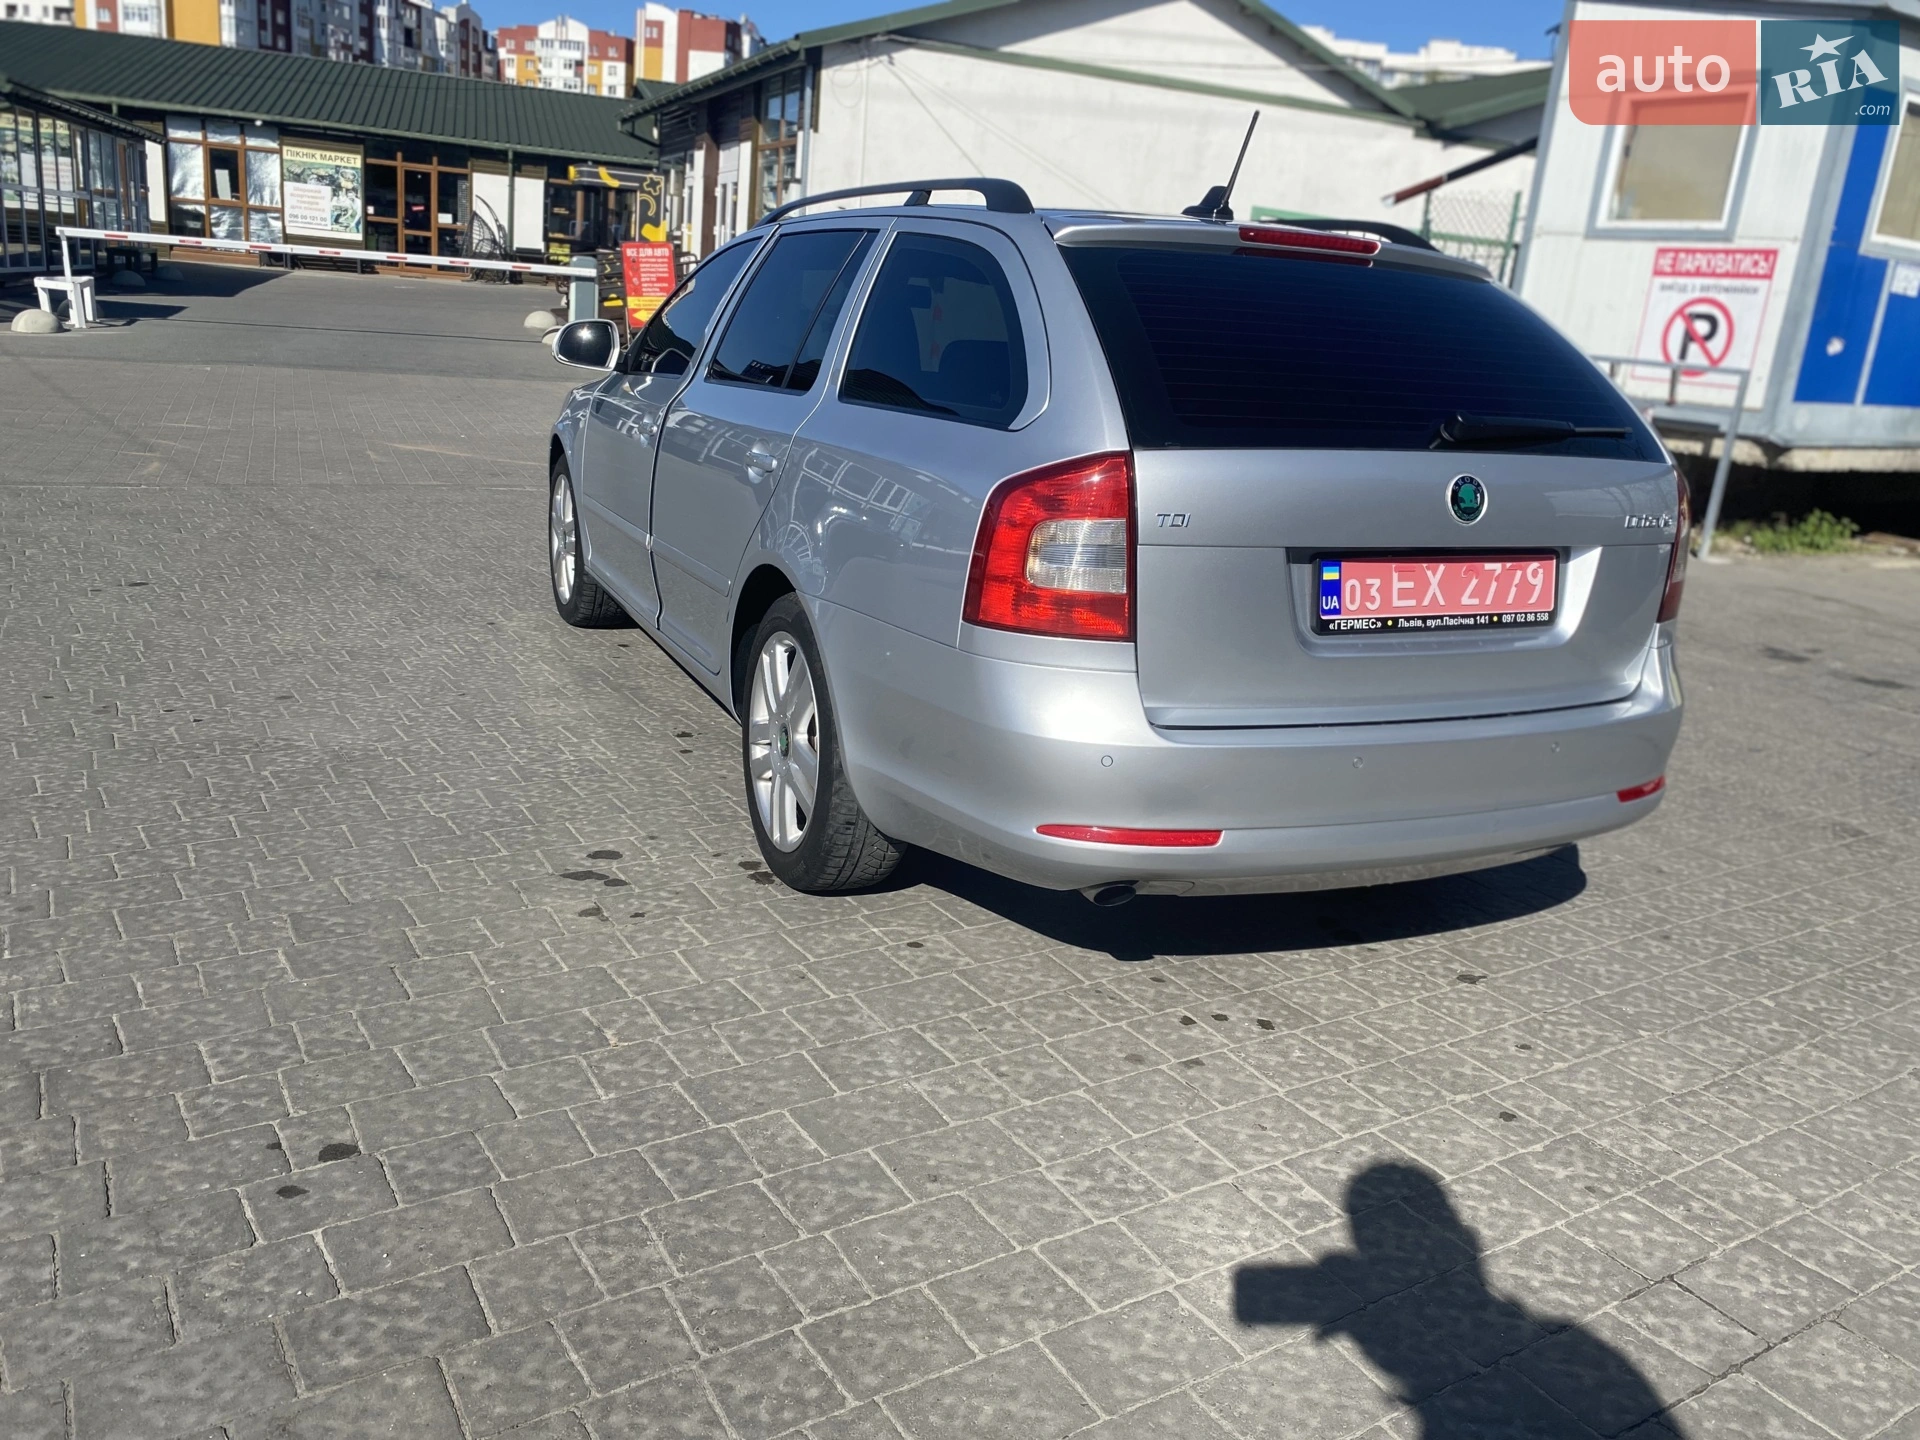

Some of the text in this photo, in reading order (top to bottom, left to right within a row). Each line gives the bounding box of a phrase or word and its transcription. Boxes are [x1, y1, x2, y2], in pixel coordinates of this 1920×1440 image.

[286, 149, 358, 165] ПІКНІК МАРКЕТ
[1657, 251, 1677, 274] НЕ
[1155, 513, 1191, 528] TDI
[1345, 562, 1544, 611] 03 EX 2779
[1322, 595, 1339, 610] UA
[1328, 618, 1382, 630] «ГЕРМЕС»
[1397, 618, 1425, 628] Львів,
[1476, 615, 1489, 624] 141
[1502, 614, 1514, 623] 097
[1516, 613, 1525, 622] 02
[1526, 613, 1535, 622] 86
[1536, 612, 1549, 621] 558
